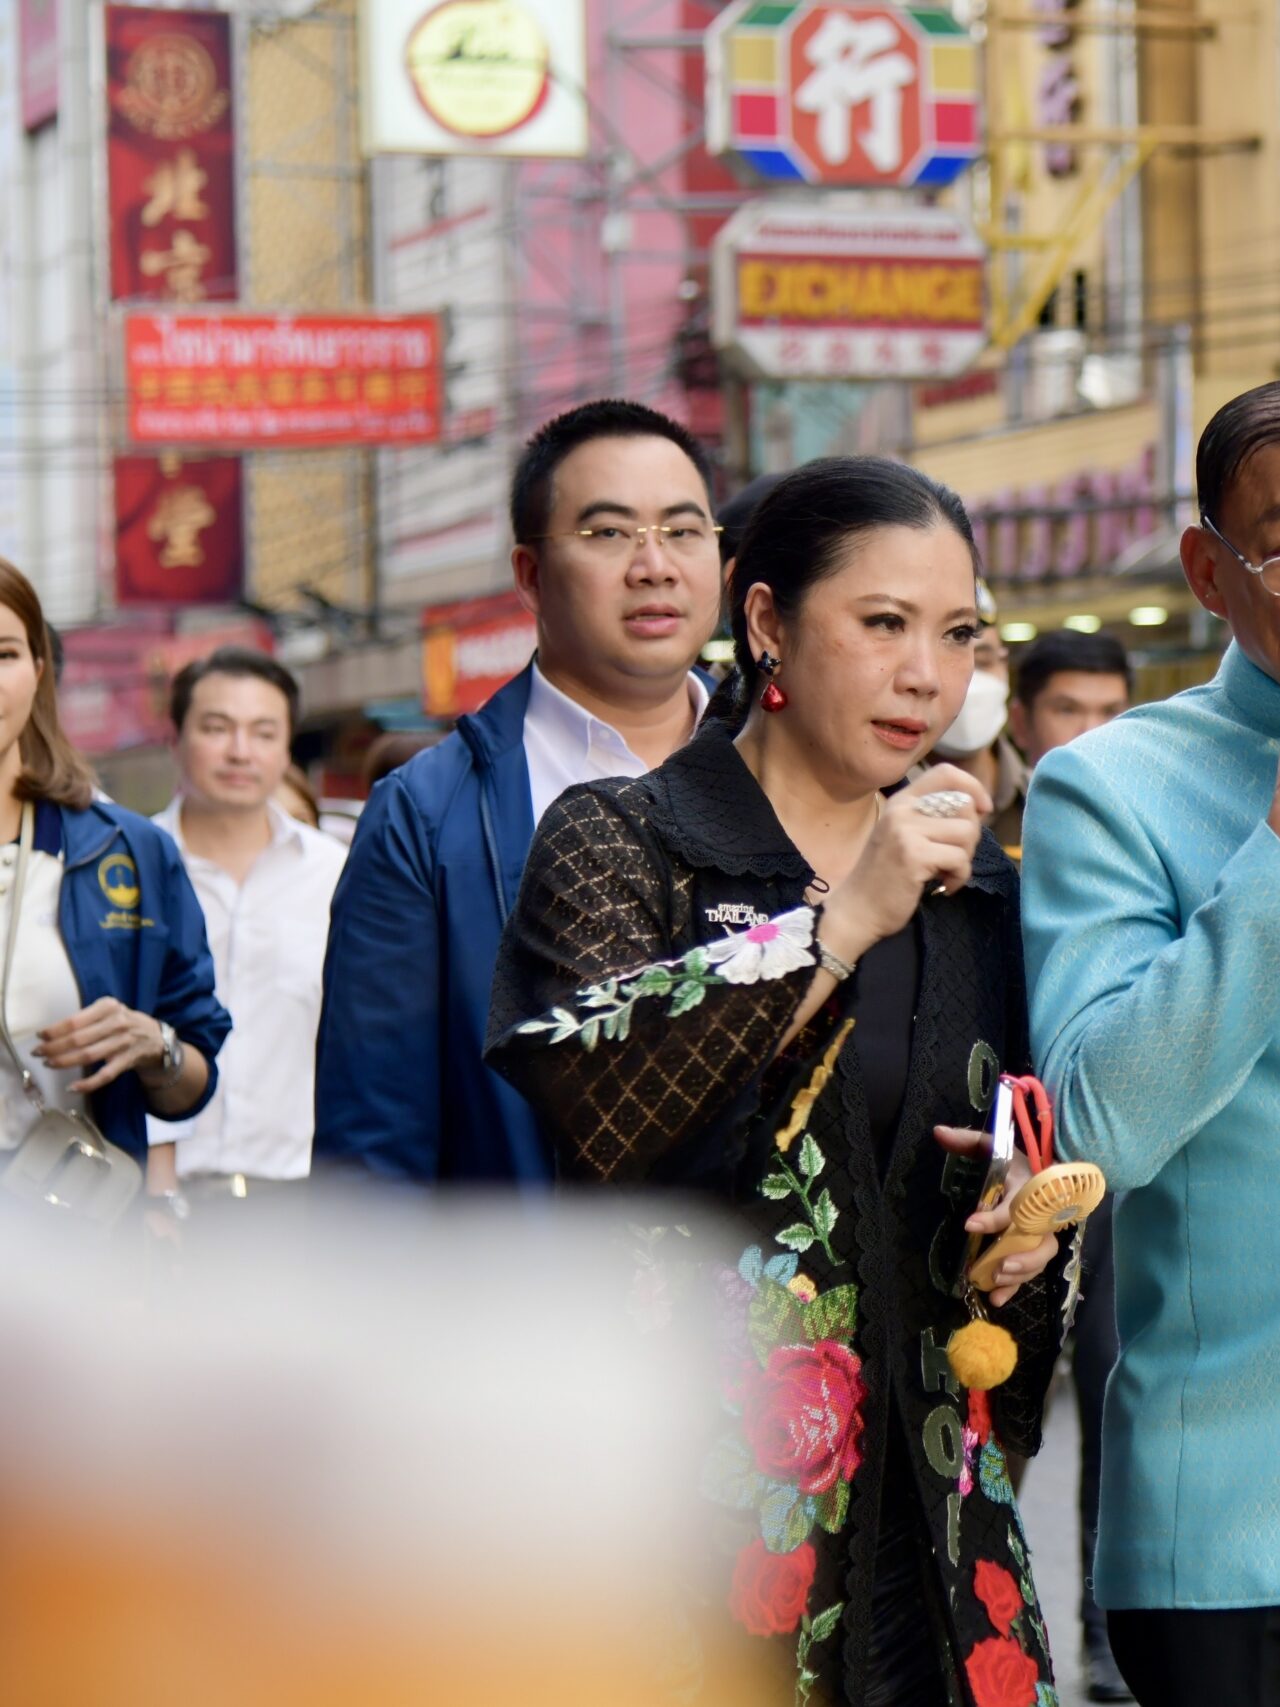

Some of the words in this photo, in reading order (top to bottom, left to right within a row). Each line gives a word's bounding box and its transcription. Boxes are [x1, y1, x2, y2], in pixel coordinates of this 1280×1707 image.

[796, 11, 916, 172] 行
[741, 260, 983, 321] EXCHANGE
[704, 909, 769, 927] THAILAND
